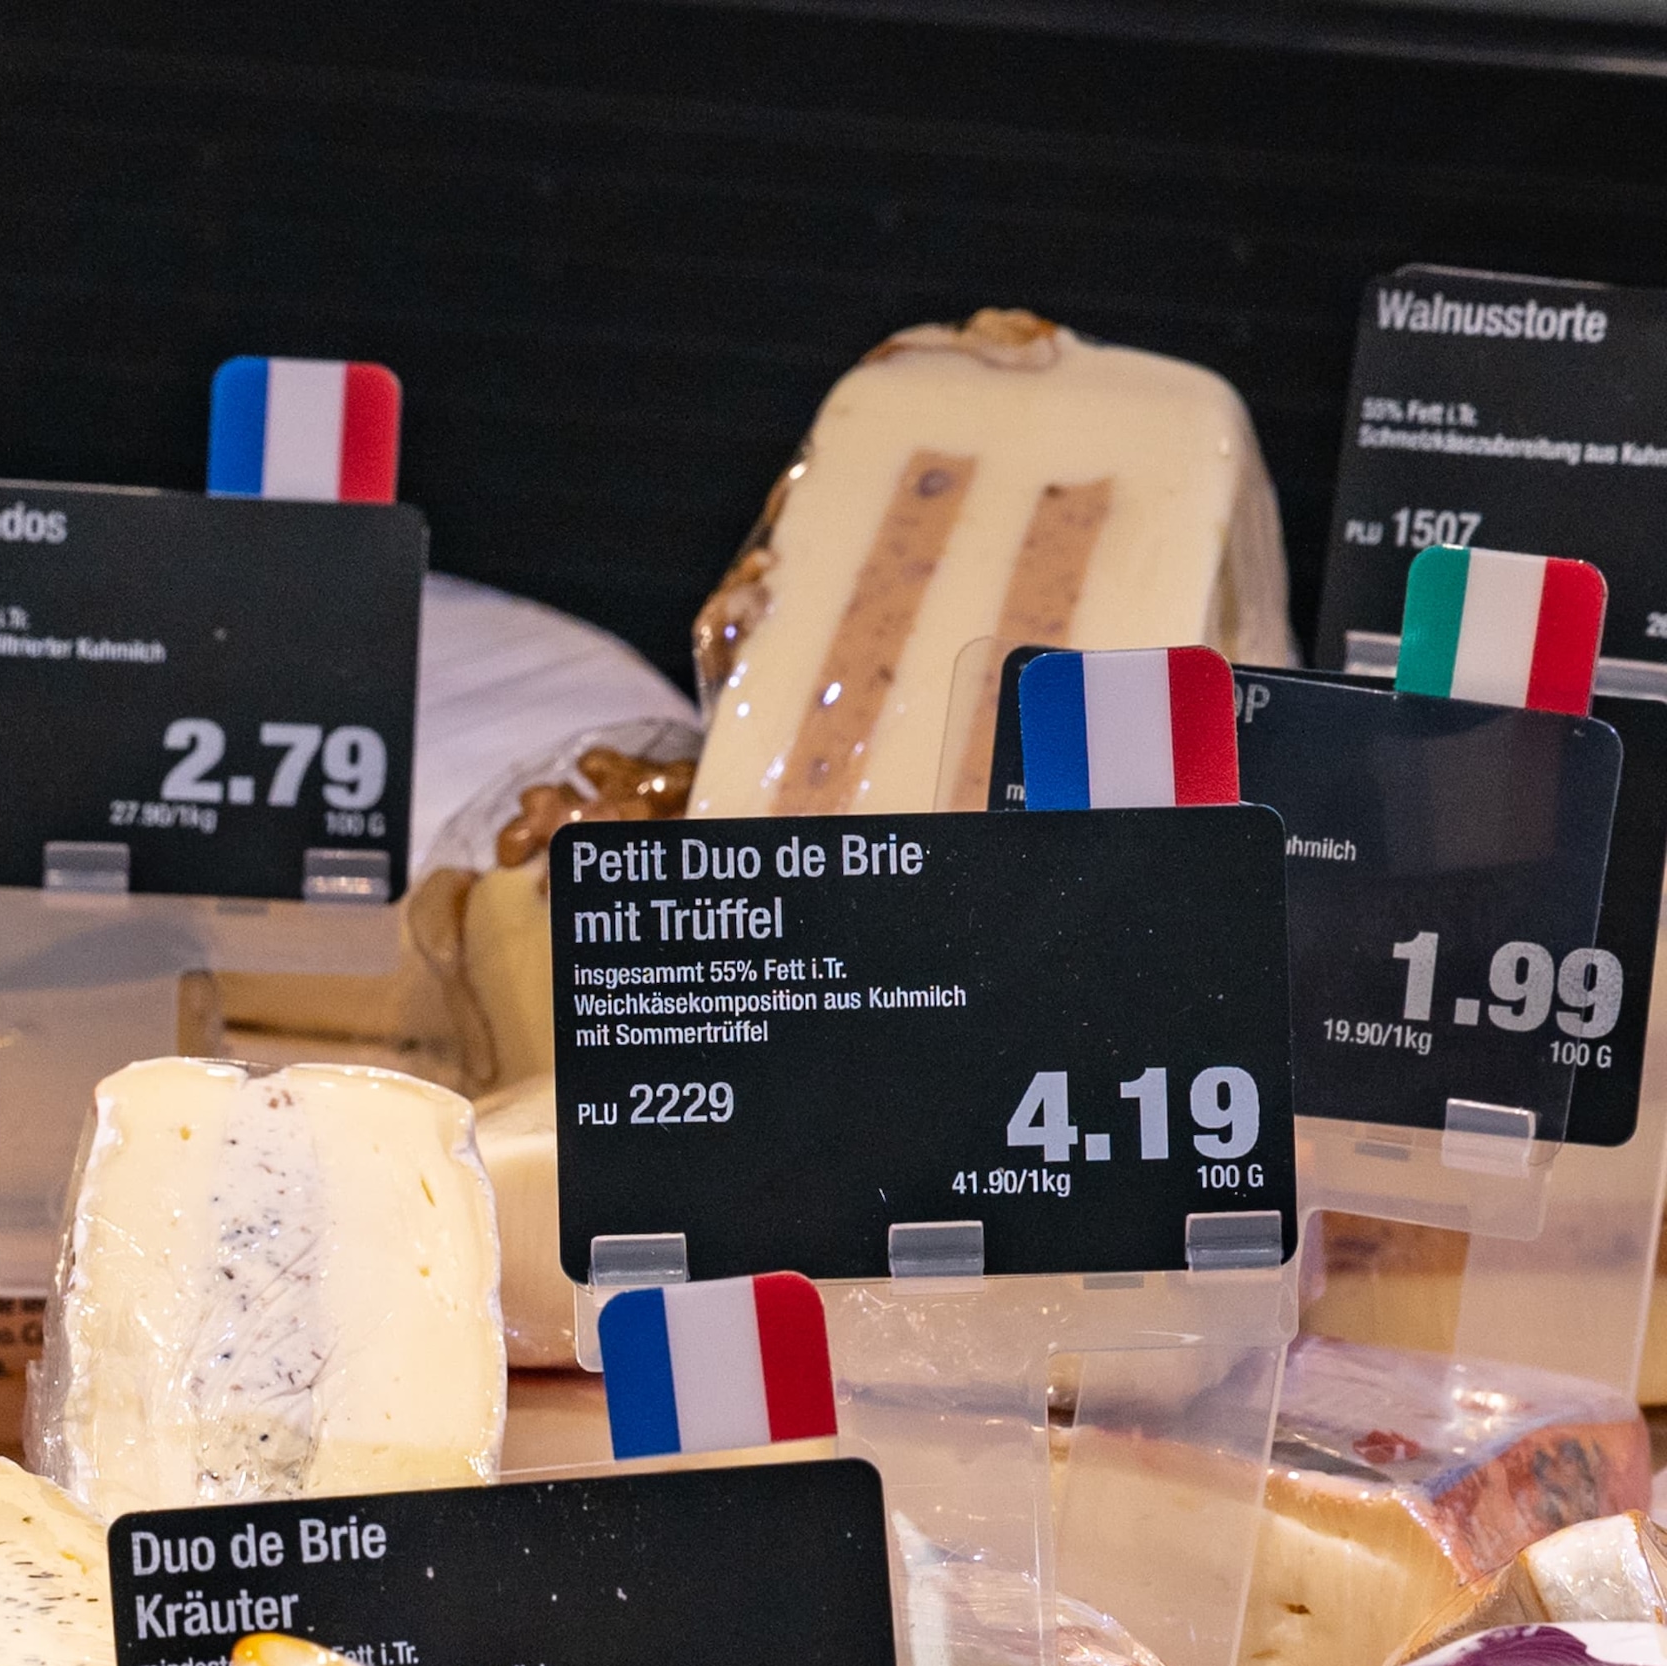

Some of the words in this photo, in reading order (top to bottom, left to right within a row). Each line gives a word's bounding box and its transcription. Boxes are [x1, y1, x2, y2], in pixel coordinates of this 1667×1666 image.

[1377, 289, 1608, 344] Walnusstorte
[1344, 519, 1383, 541] PLU
[1393, 507, 1481, 549] 1507
[160, 717, 387, 810] 2.79
[572, 839, 668, 883] Petit
[681, 837, 762, 881] Duo
[775, 835, 827, 879] de
[841, 832, 924, 876] Brie
[573, 899, 642, 944] mit
[649, 895, 783, 941] Trüffel
[573, 960, 705, 990] insgesammt
[709, 958, 758, 983] 55%
[763, 958, 806, 981] Fett
[810, 956, 847, 980] i.Tr.
[1391, 930, 1624, 1039] 1.99
[573, 988, 817, 1017] Weichkäsekomposition
[823, 991, 862, 1011] aus
[868, 984, 967, 1009] Kuhmilch
[575, 1023, 611, 1047] mit
[615, 1019, 769, 1046] Sommertrüffel
[1322, 1017, 1433, 1056] 19.90/1kg
[1549, 1039, 1591, 1067] 100
[1595, 1044, 1612, 1069] G
[577, 1101, 618, 1126] PLU
[628, 1080, 735, 1125] 2229
[1005, 1065, 1261, 1163] 4.19
[951, 1167, 1071, 1198] 41.90/1kg
[1196, 1163, 1240, 1189] 100
[1247, 1162, 1264, 1188] G
[130, 1530, 216, 1576] Duo
[229, 1522, 285, 1569] de
[298, 1514, 387, 1564] Brie
[134, 1588, 299, 1640] Kräuter
[380, 1641, 420, 1666] i.Tr.
